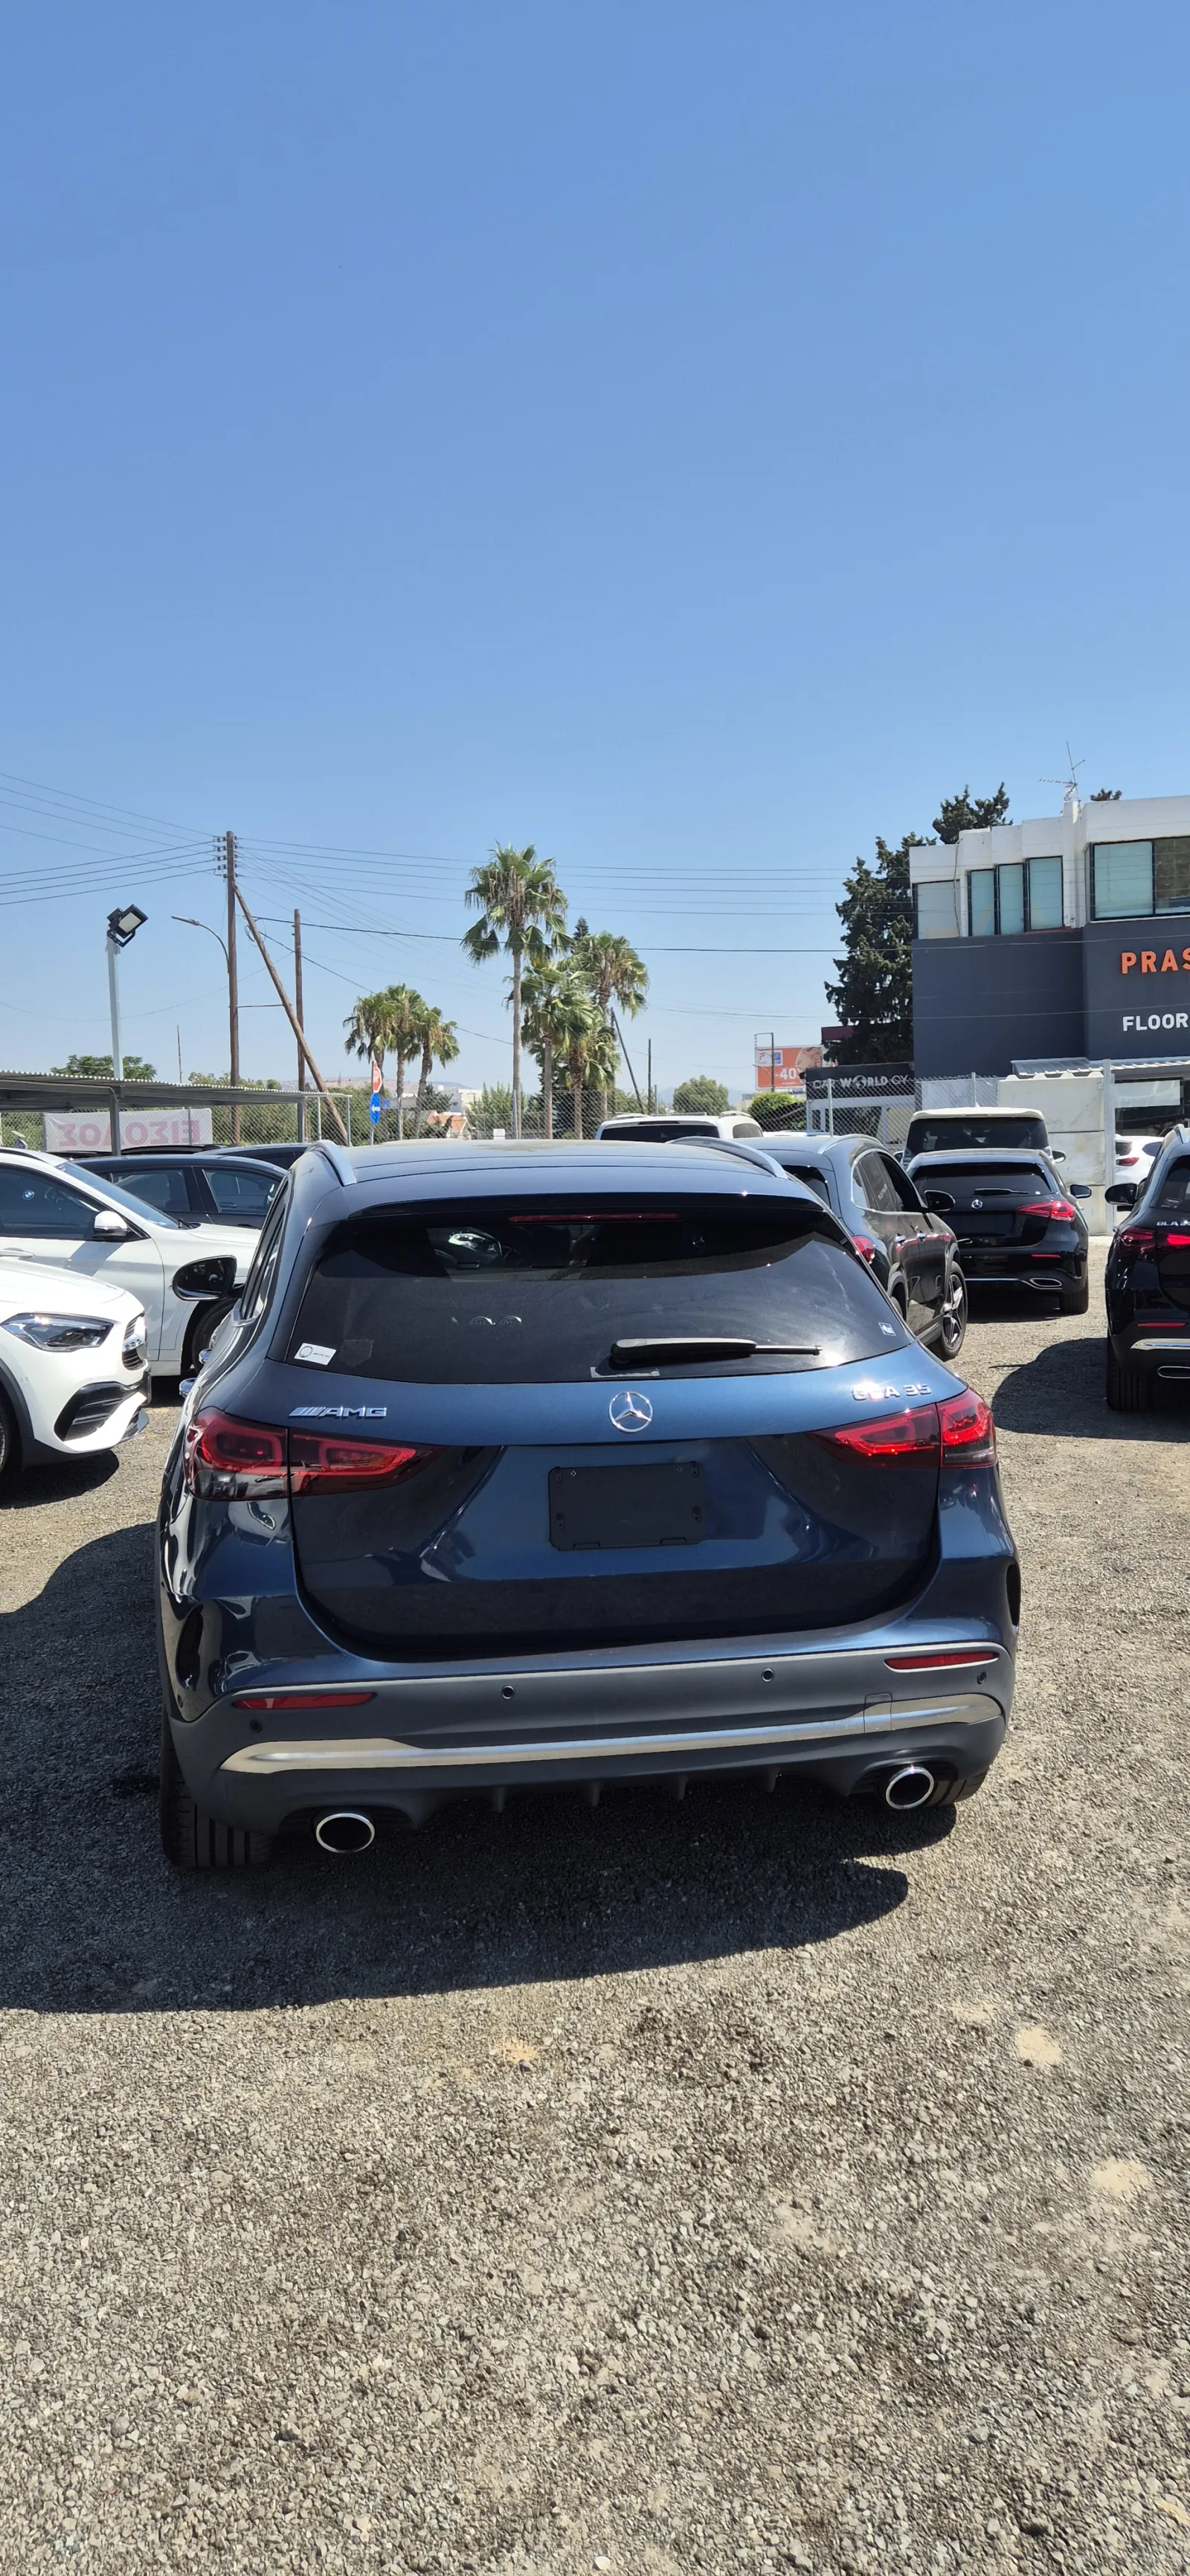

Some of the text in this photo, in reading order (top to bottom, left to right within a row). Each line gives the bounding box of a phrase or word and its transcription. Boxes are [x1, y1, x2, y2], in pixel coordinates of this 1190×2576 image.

[1122, 1012, 1189, 1031] FLOOR
[774, 1067, 801, 1079] -40
[813, 1079, 835, 1089] CAR
[840, 1075, 888, 1089] WORLD
[903, 1384, 931, 1395] 35
[318, 1405, 387, 1418] AMG
